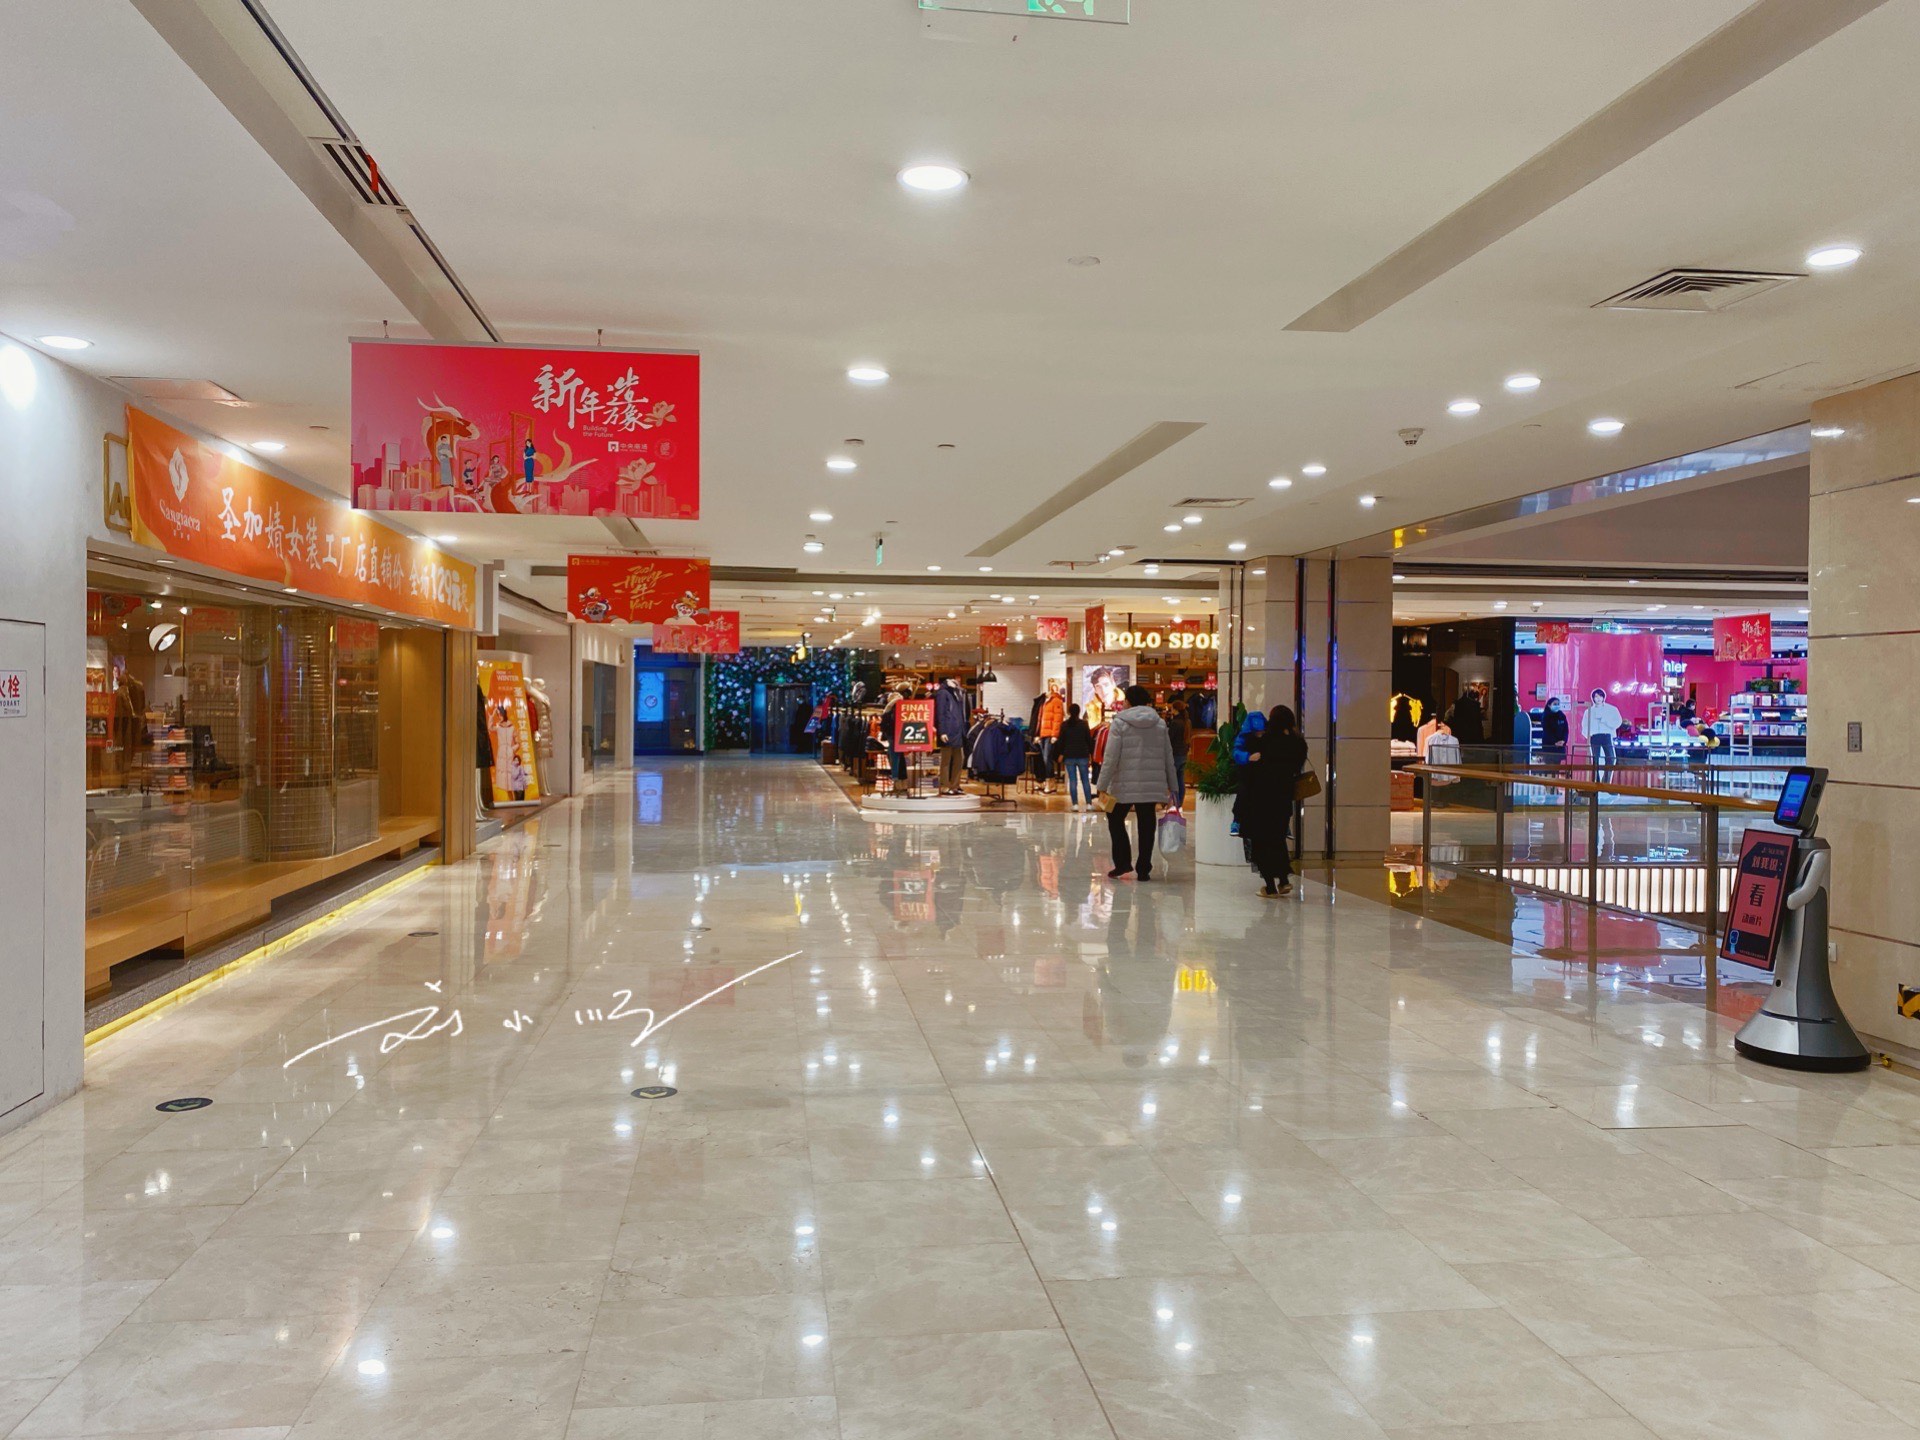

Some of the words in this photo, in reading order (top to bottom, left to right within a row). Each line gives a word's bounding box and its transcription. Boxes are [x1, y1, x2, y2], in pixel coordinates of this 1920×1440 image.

[582, 424, 608, 433] Building
[1104, 631, 1162, 649] POLO
[901, 703, 930, 712] FINAL
[901, 711, 930, 722] SALE
[1749, 883, 1766, 907] 看
